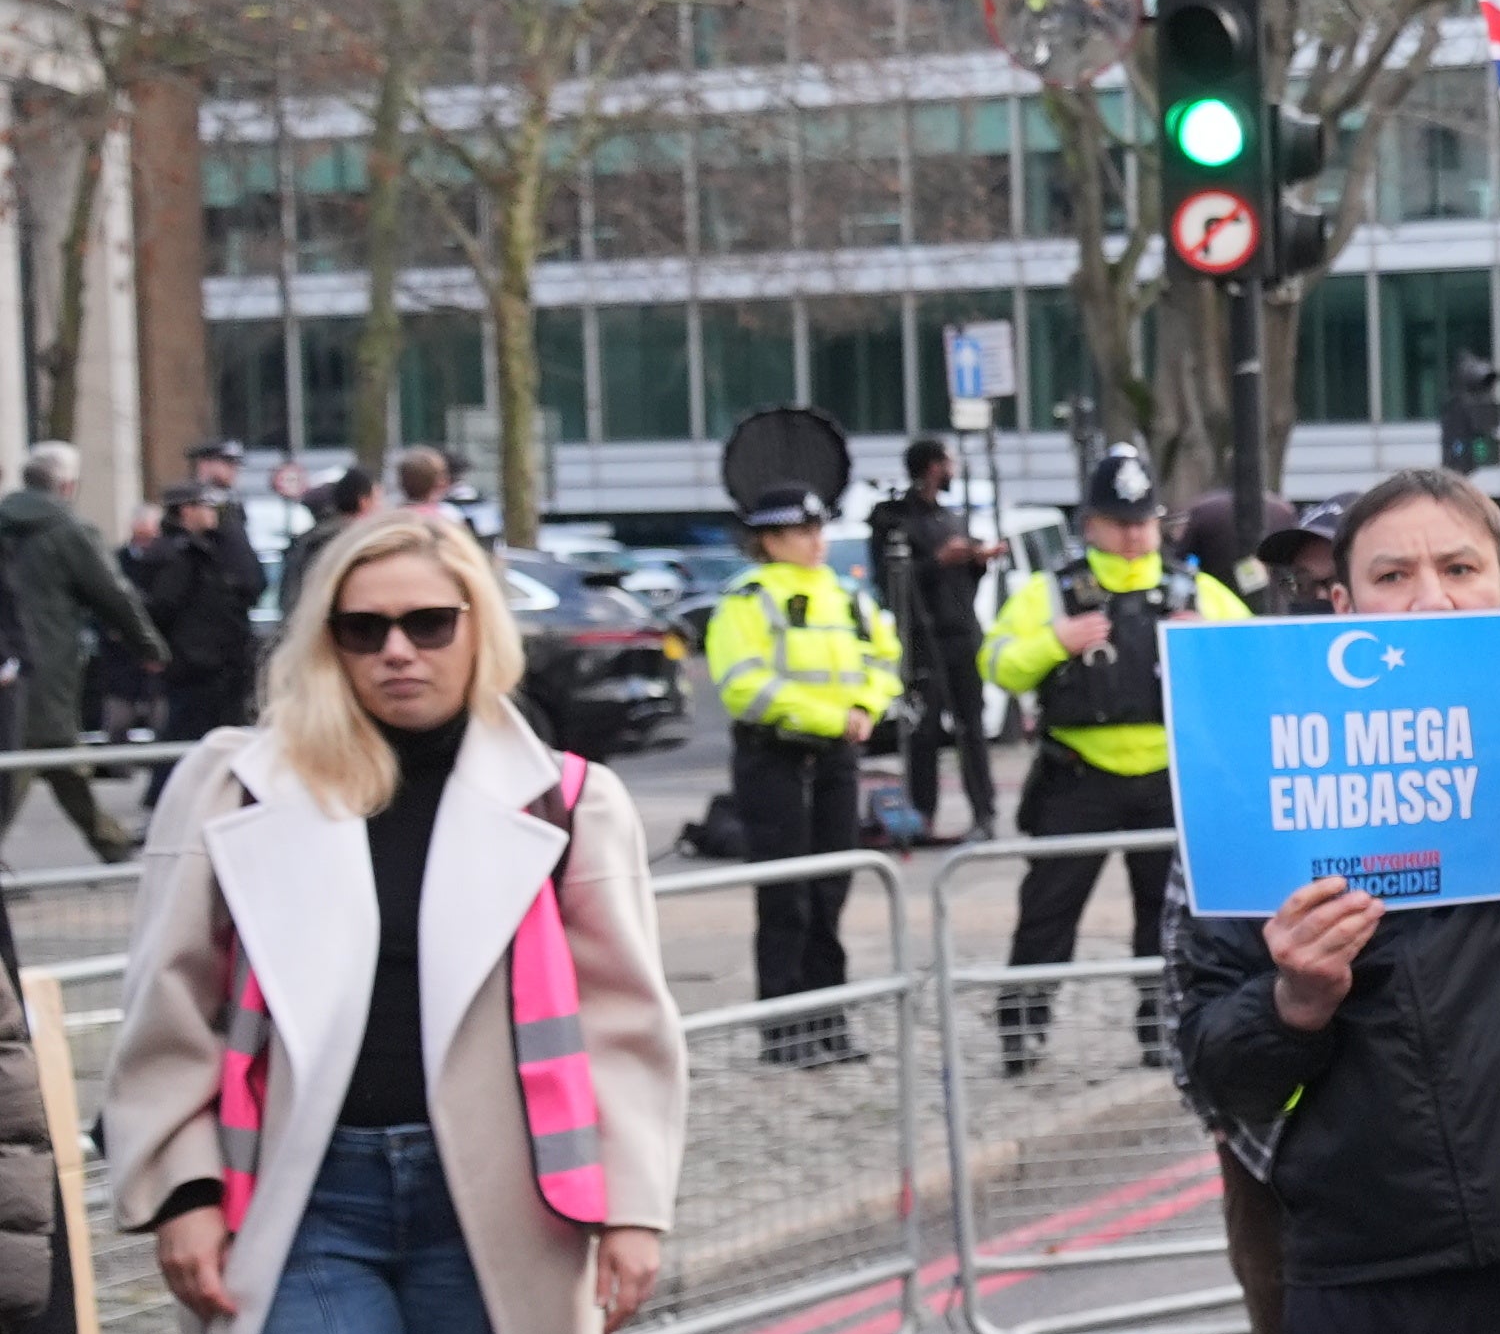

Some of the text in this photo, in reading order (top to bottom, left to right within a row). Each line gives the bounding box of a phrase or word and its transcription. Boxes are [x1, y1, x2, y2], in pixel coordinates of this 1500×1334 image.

[1270, 706, 1473, 769] NO MEGA
[1269, 766, 1478, 831] EMBASSY
